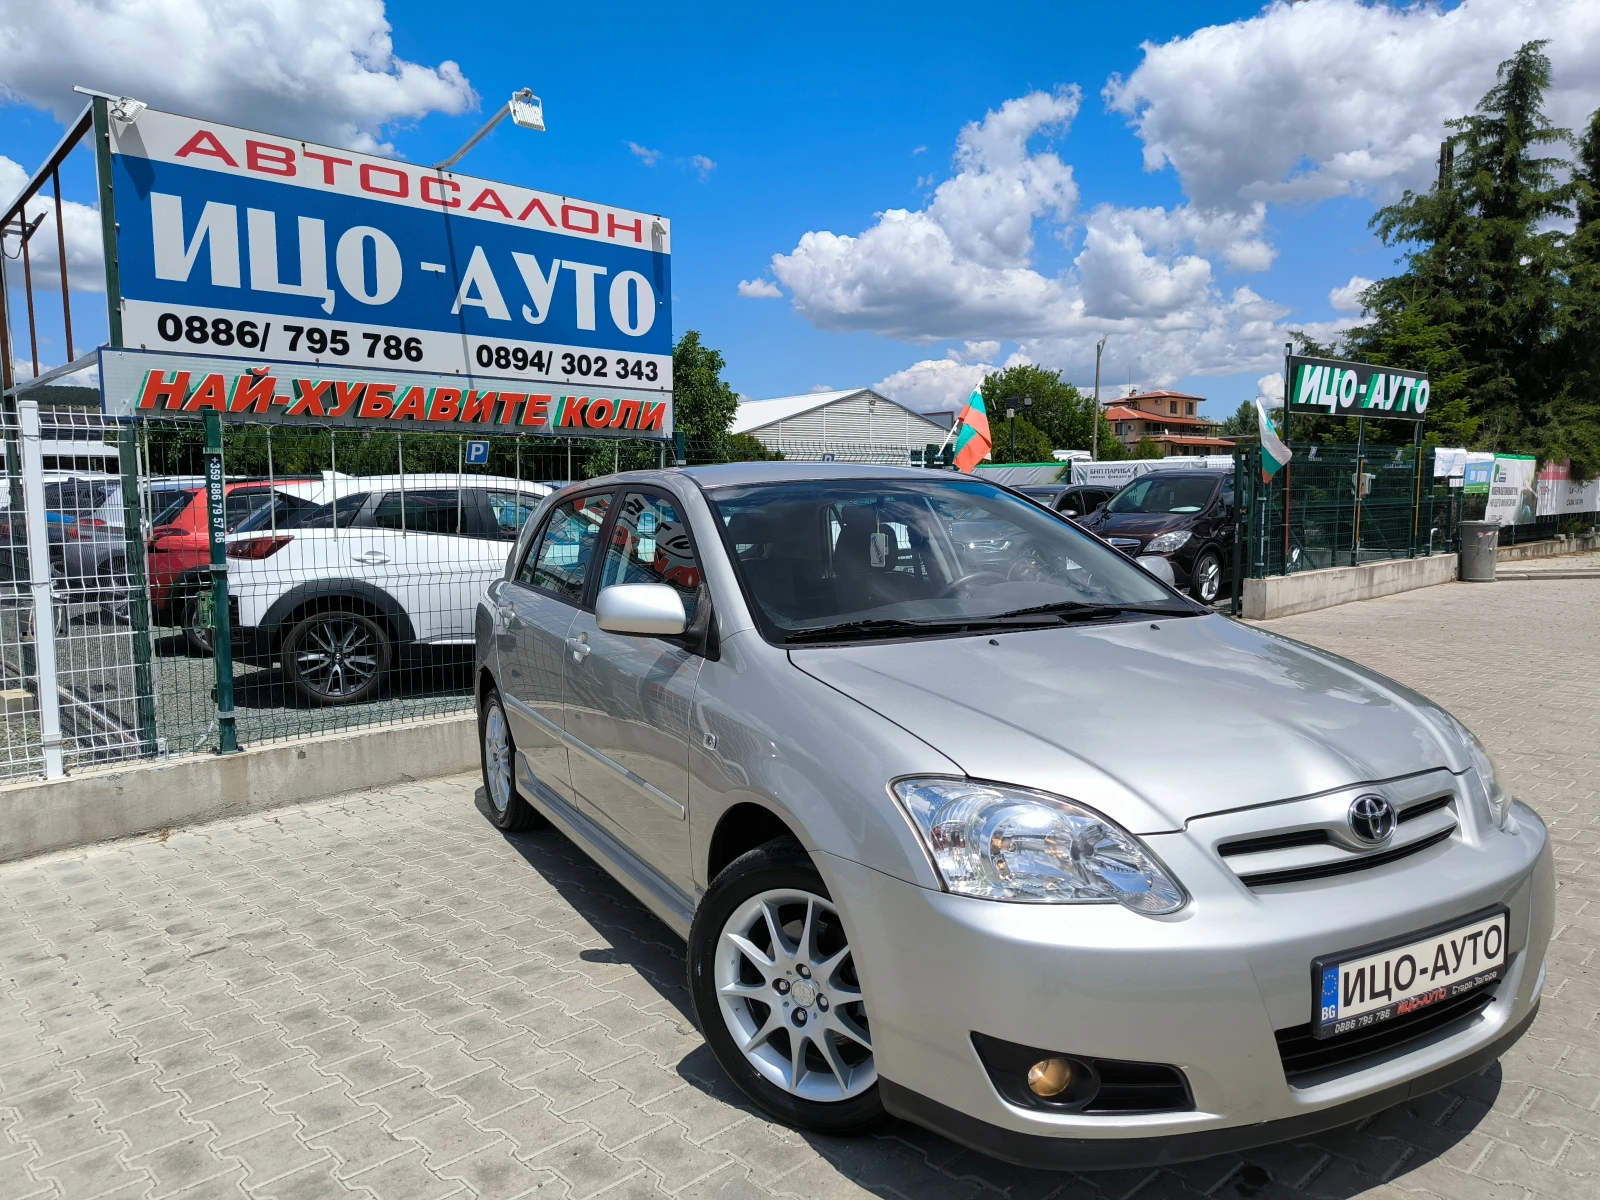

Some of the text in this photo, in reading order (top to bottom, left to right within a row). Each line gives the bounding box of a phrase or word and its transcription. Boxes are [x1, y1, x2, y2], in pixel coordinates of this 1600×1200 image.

[174, 129, 643, 243] АВТОСАЛОН
[157, 312, 423, 363] 0886/ 795 786
[476, 343, 658, 382] 0894/ 302 343
[138, 366, 666, 431] НАЙ-ХУБАВИТЕ КОЛИ
[1299, 364, 1430, 414] ИЦО-АУТО
[471, 444, 484, 460] P
[210, 457, 225, 543] +359 886 79 57 86
[1342, 924, 1502, 1008] ИЦО-АУТО
[1321, 1004, 1336, 1021] BG
[1334, 1019, 1356, 1034] 0886
[1358, 1014, 1374, 1027] 795
[1375, 1009, 1391, 1023] 786
